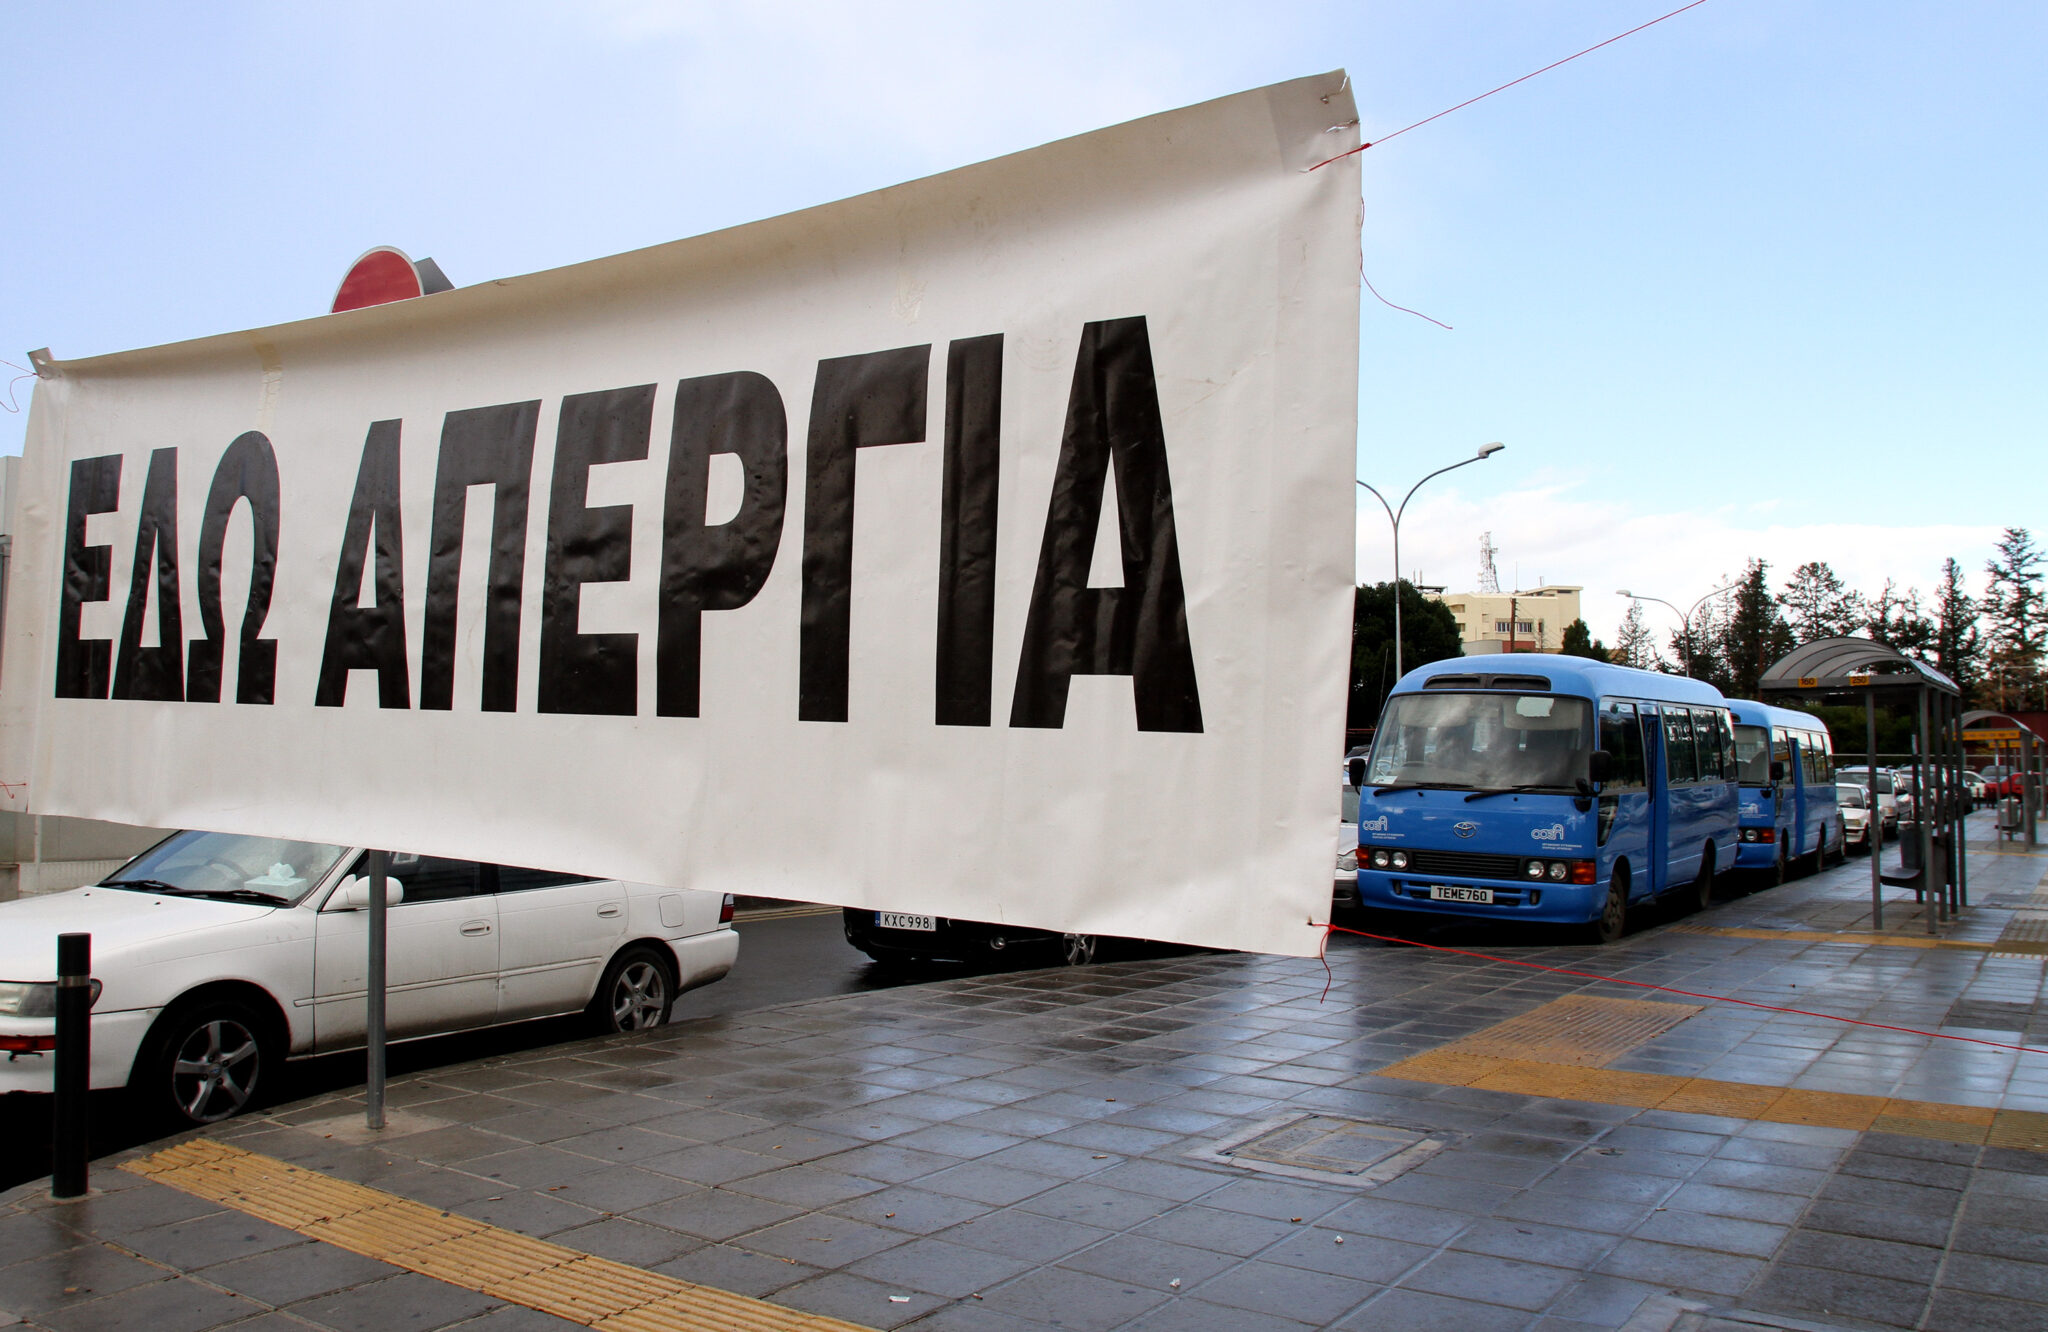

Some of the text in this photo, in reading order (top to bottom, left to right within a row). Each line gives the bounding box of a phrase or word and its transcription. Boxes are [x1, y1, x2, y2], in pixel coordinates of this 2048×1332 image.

[55, 315, 1205, 734] ΕΔΩ ΑΠΕΡΓΙΑ
[1437, 887, 1487, 902] TEME760
[884, 913, 930, 929] KXC998
